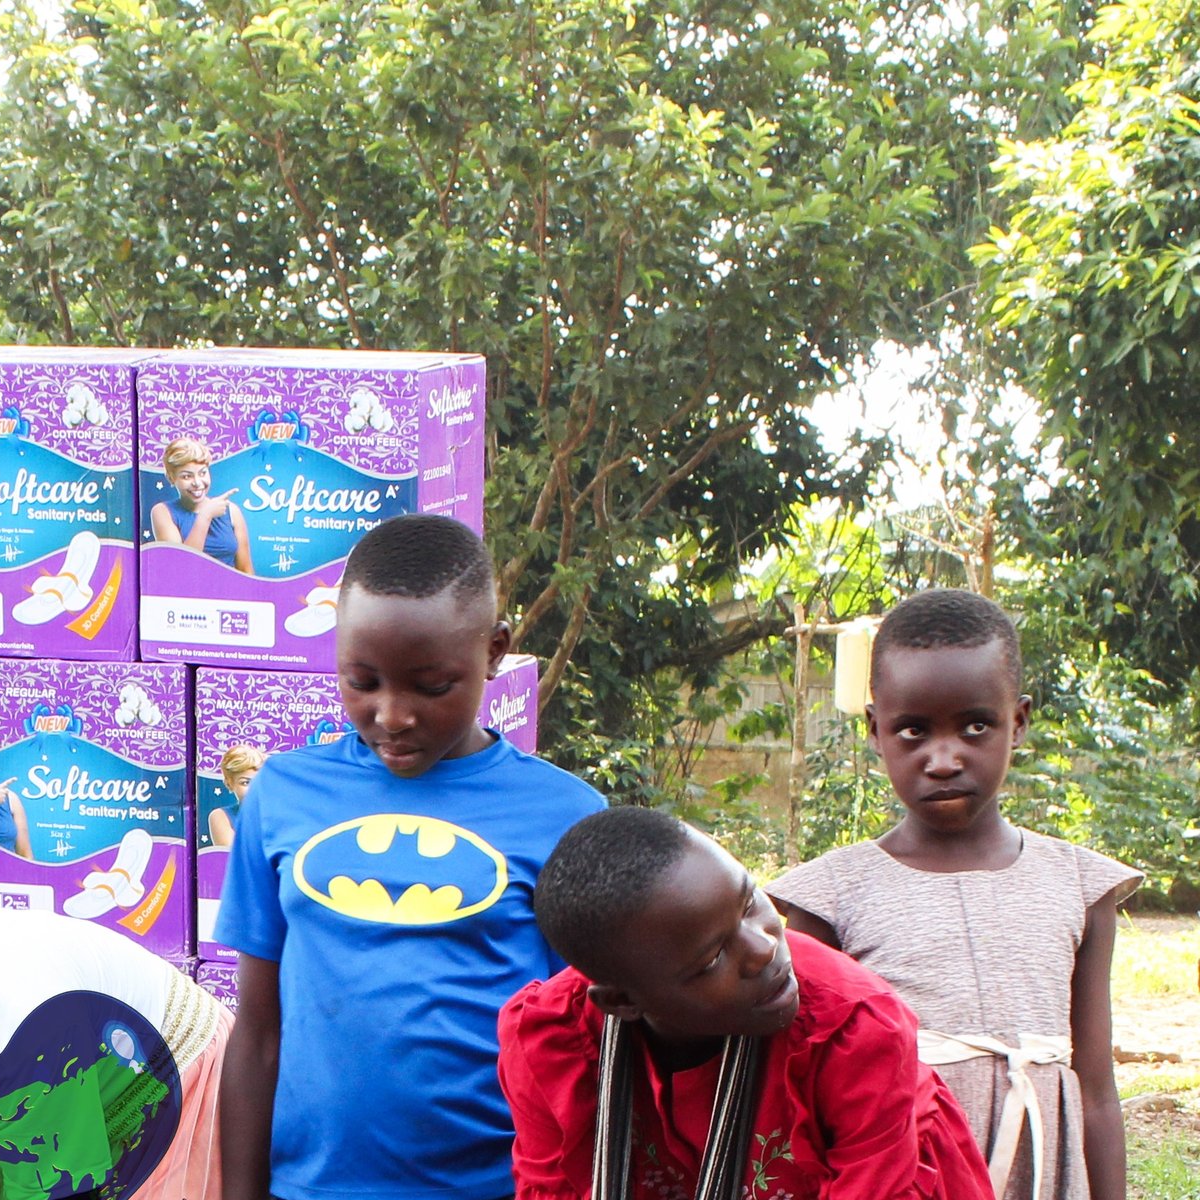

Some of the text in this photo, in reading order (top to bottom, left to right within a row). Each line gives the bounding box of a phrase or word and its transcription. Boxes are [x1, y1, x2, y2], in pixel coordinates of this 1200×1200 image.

[157, 391, 282, 405] MAXI THICK REGULAR
[427, 385, 472, 424] Softcare
[258, 422, 296, 440] NEW
[332, 435, 403, 448] COTTON FEEL
[243, 474, 382, 524] Softcare
[27, 508, 107, 524] Sanitary Pads
[303, 516, 356, 534] Sanitary
[488, 694, 526, 731] Softcare
[104, 727, 171, 741] COTTON FEEL
[21, 764, 153, 811] Softcare
[79, 805, 159, 822] Sanitary Pads
